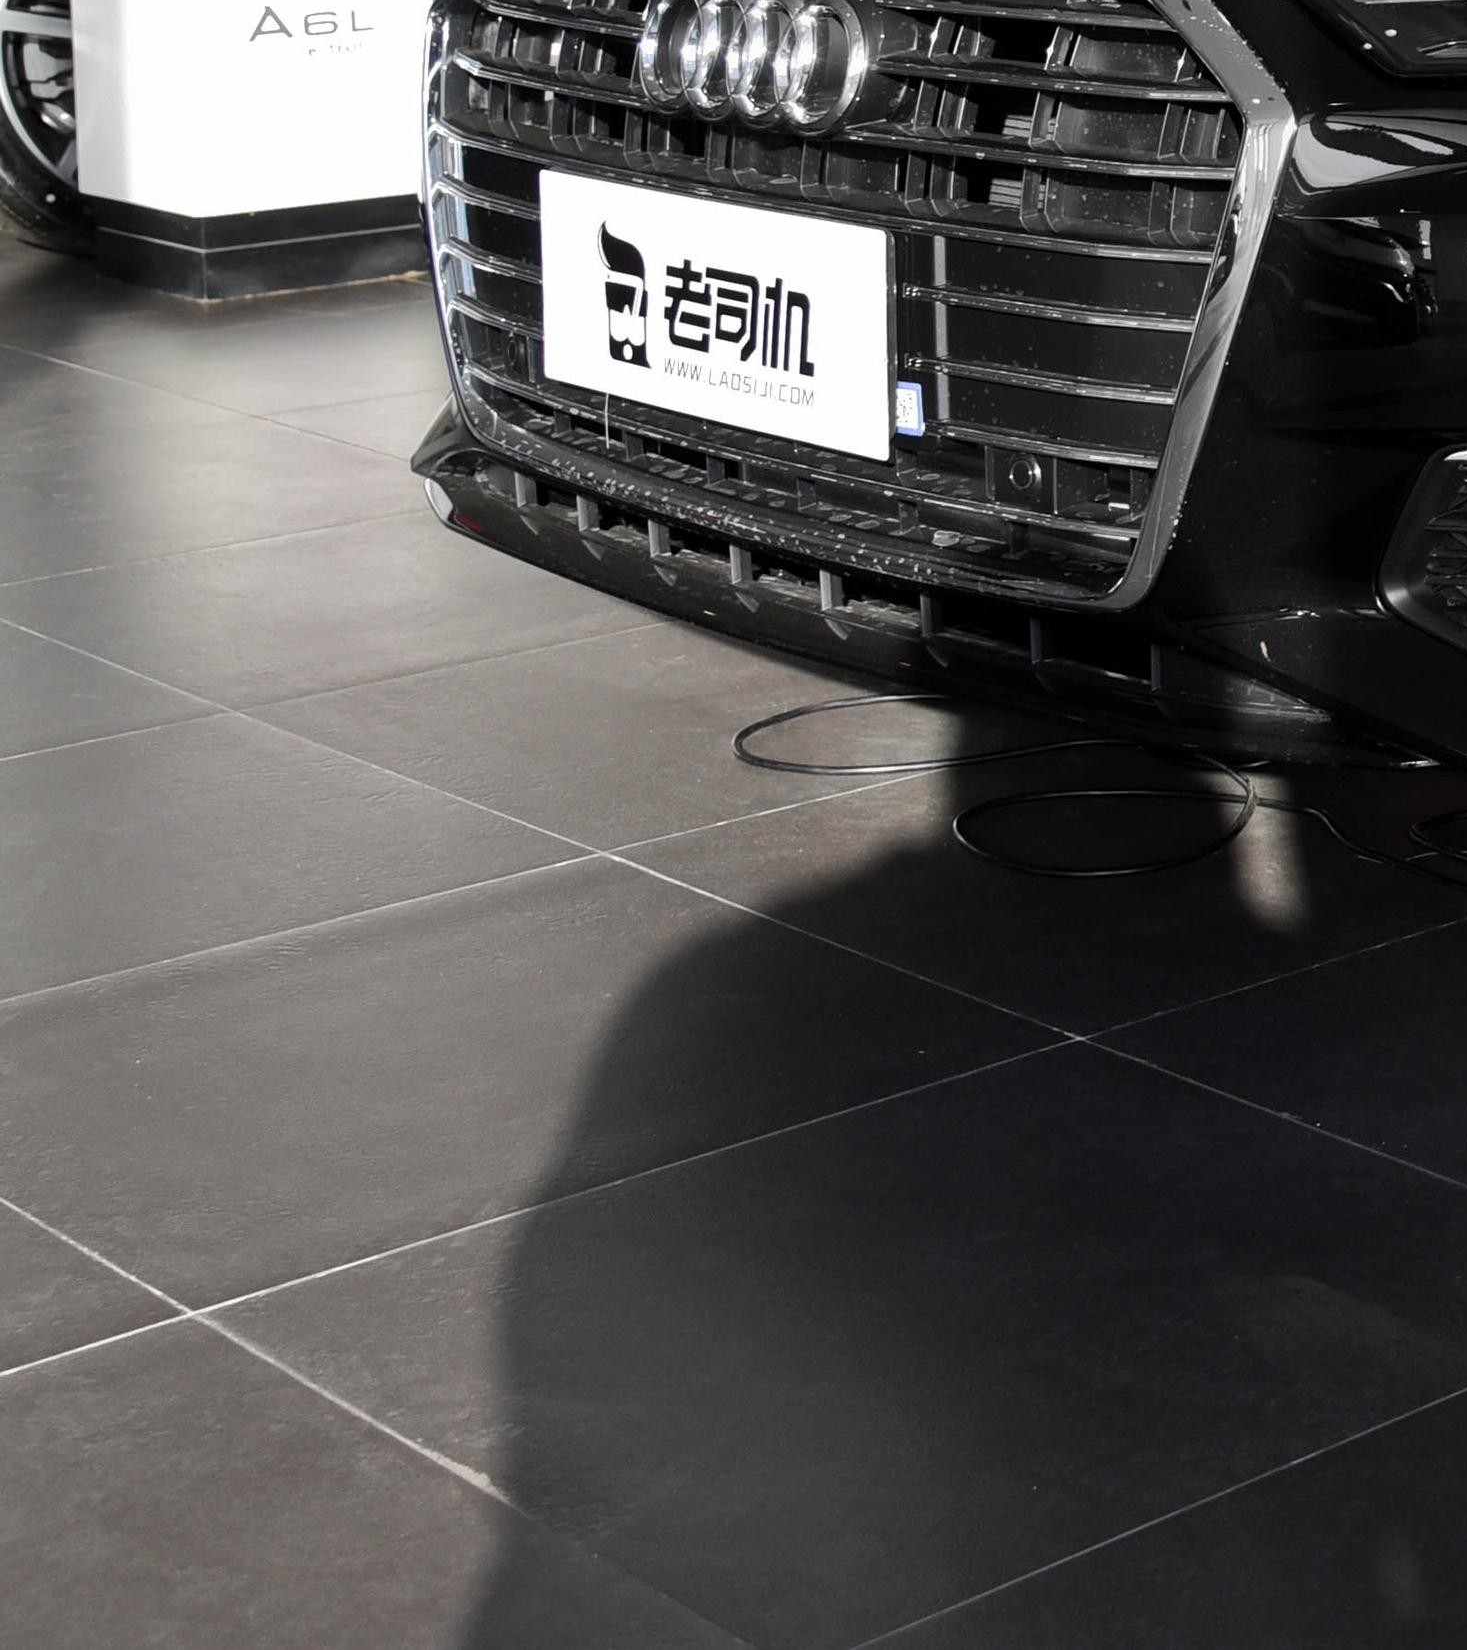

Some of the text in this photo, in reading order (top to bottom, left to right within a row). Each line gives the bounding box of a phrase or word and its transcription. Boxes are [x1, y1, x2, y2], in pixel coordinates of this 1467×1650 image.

[248, 5, 375, 42] A6L
[664, 259, 814, 377] 老司机
[664, 358, 815, 407] WWW.LAOSIJI.COM
